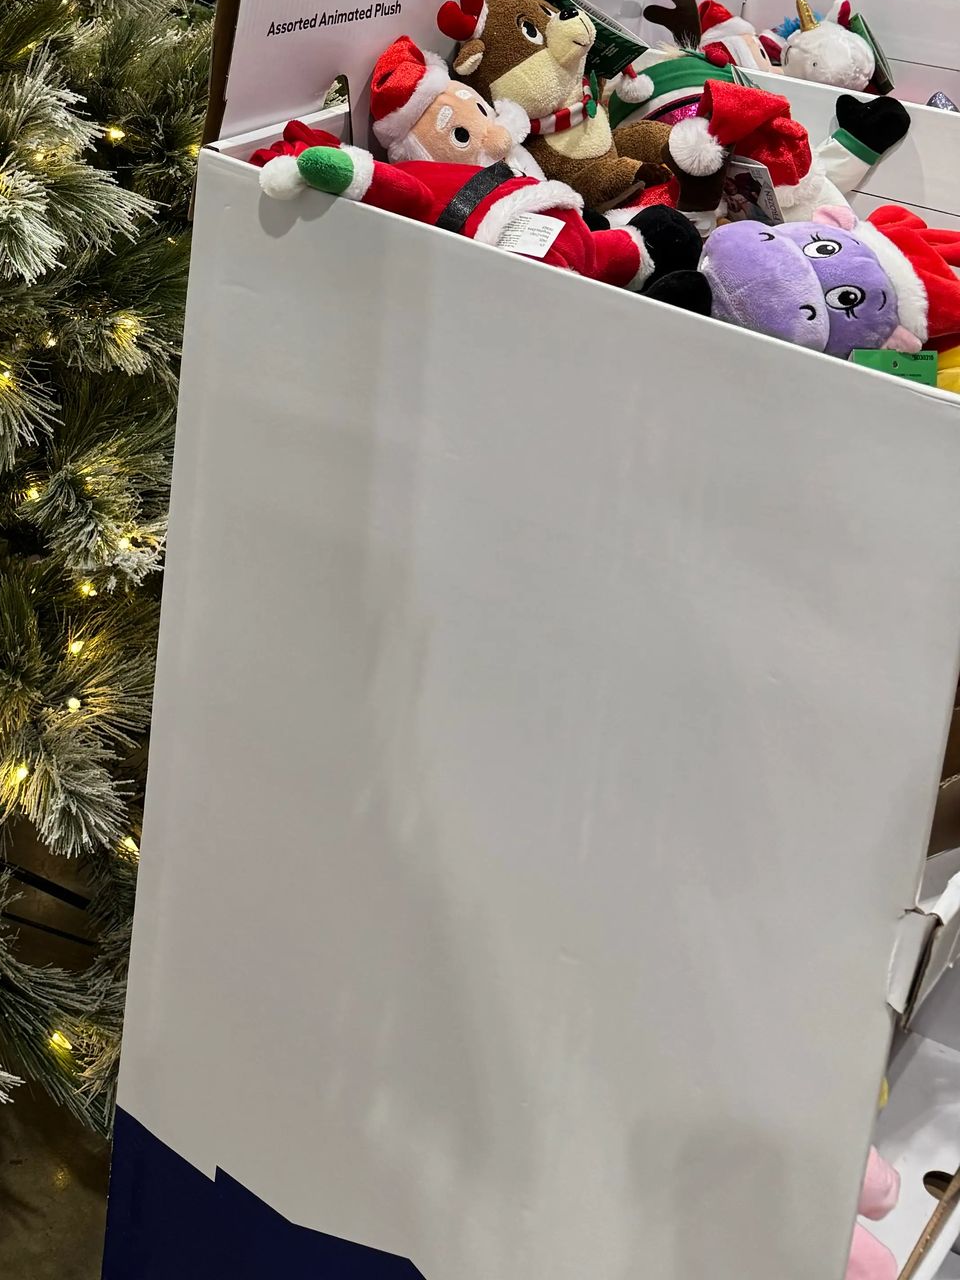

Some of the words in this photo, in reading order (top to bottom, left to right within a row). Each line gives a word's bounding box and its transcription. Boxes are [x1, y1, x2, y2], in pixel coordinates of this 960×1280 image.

[266, 13, 318, 37] Assorted
[318, 4, 373, 28] Animated
[374, 0, 402, 18] Plush
[764, 189, 780, 220] FROZEN
